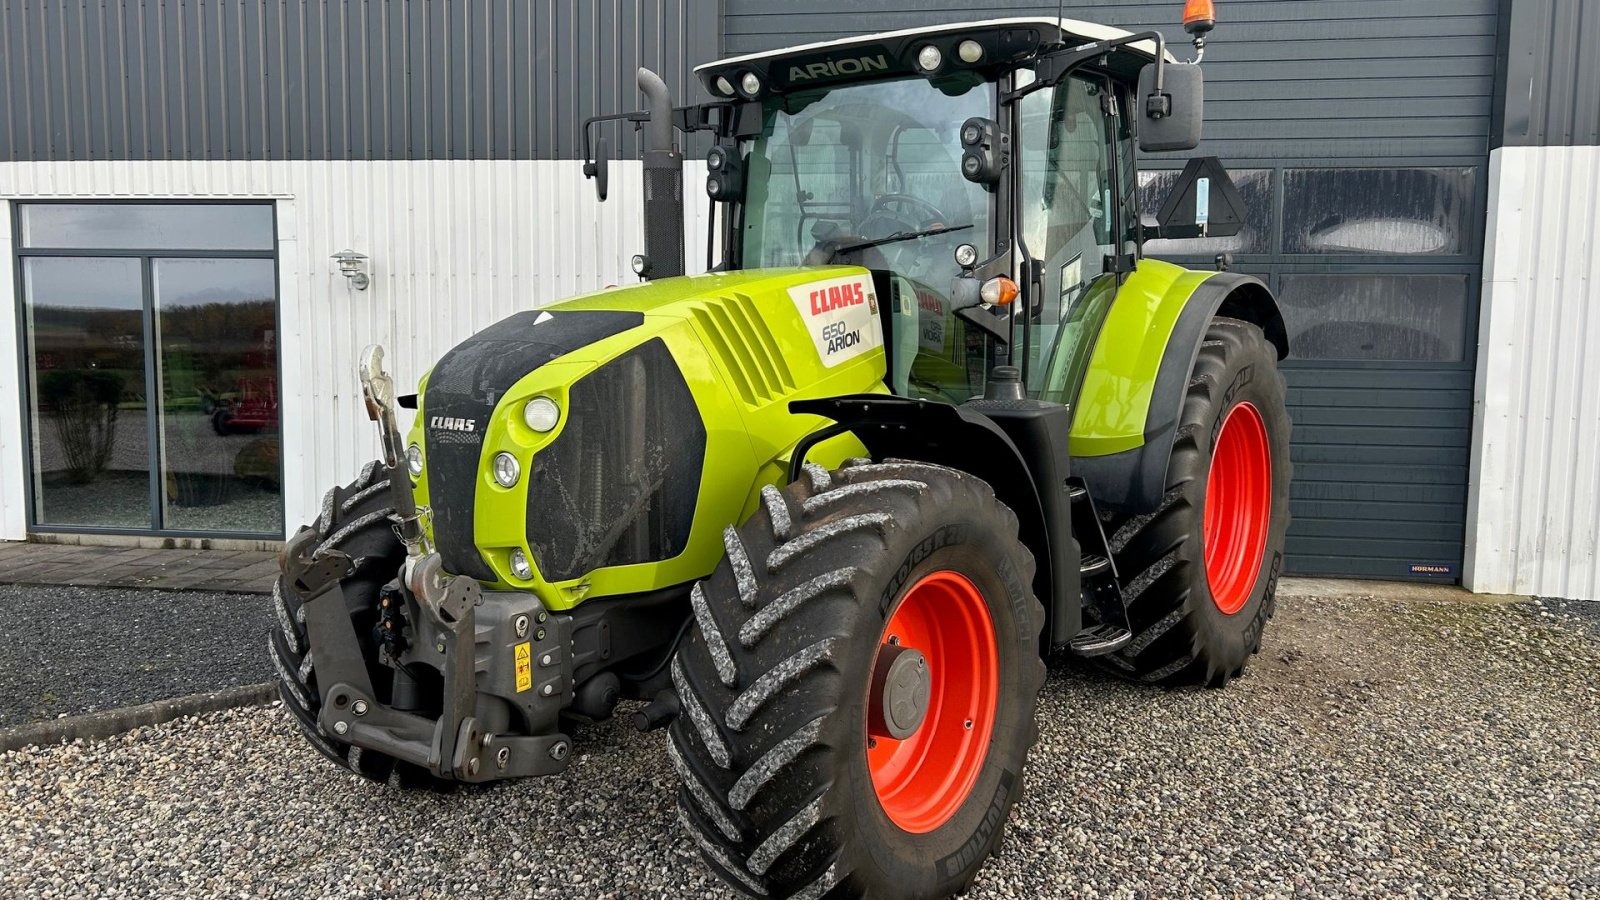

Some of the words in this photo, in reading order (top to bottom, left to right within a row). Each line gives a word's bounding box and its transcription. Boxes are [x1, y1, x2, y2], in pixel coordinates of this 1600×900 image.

[810, 282, 864, 316] CLAAS
[823, 320, 846, 341] 650
[827, 330, 860, 355] ARION
[430, 416, 476, 432] CLAAS
